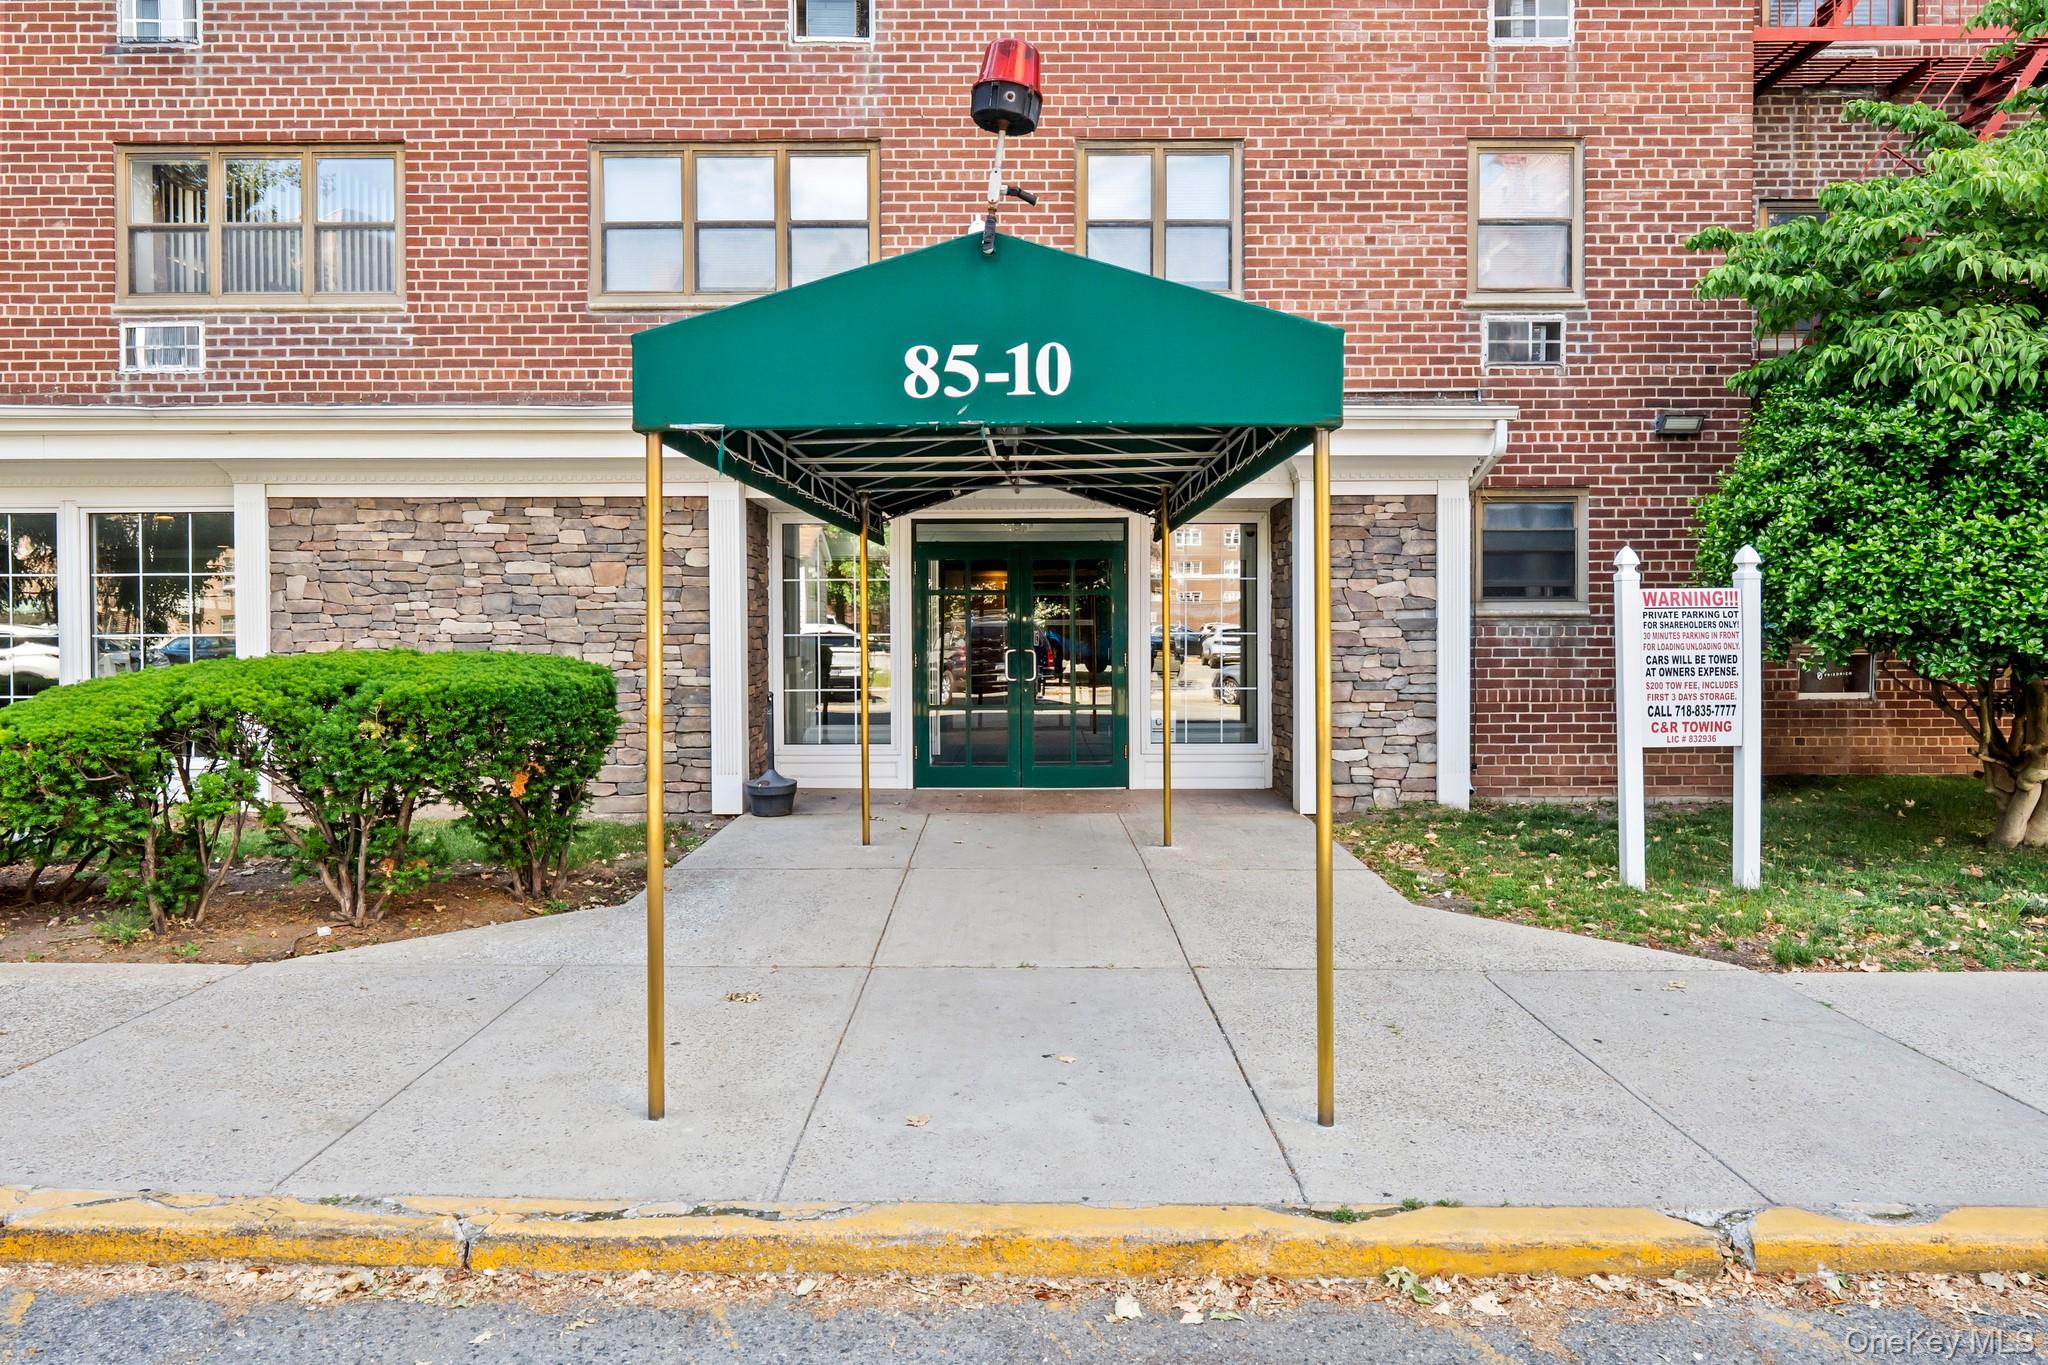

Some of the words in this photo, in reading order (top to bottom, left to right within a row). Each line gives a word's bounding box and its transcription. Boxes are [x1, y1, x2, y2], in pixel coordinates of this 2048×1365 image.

[903, 341, 1072, 399] 85-10
[1642, 591, 1738, 606] WARNING!!!
[1642, 611, 1678, 619] PRIVATE
[1681, 611, 1720, 619] PARKING
[1722, 610, 1739, 618] LOT
[1643, 621, 1658, 629] FOR
[1659, 621, 1717, 629] SHAREHOLDERS
[1718, 620, 1740, 628] ONLY!
[1643, 632, 1650, 640] 30
[1652, 632, 1680, 640] MINUTES
[1682, 632, 1710, 640] PARKING
[1719, 631, 1740, 639] FRONT
[1643, 643, 1655, 651] FOR
[1723, 642, 1741, 650] ONLY.
[1645, 655, 1669, 665] CARS
[1671, 655, 1692, 664] WILL
[1694, 655, 1706, 664] BE
[1708, 654, 1738, 664] TOWED
[1645, 668, 1656, 677] AT
[1658, 667, 1696, 677] OWNERS
[1698, 666, 1739, 677] EXPENSE.
[1645, 682, 1664, 690] $200
[1665, 681, 1682, 690] TOW
[1702, 681, 1739, 689] INCLUDES
[1647, 693, 1669, 701] FIRST
[1671, 693, 1676, 701] 3
[1678, 693, 1698, 701] DAYS
[1699, 692, 1737, 701] STORAGE.
[1647, 705, 1672, 717] CALL
[1675, 704, 1737, 717] 718-835-7777
[1651, 721, 1678, 733] C&R
[1681, 720, 1732, 733] TOWING
[1666, 735, 1680, 743] LIC
[1681, 735, 1687, 743] #
[1688, 735, 1717, 743] 832936
